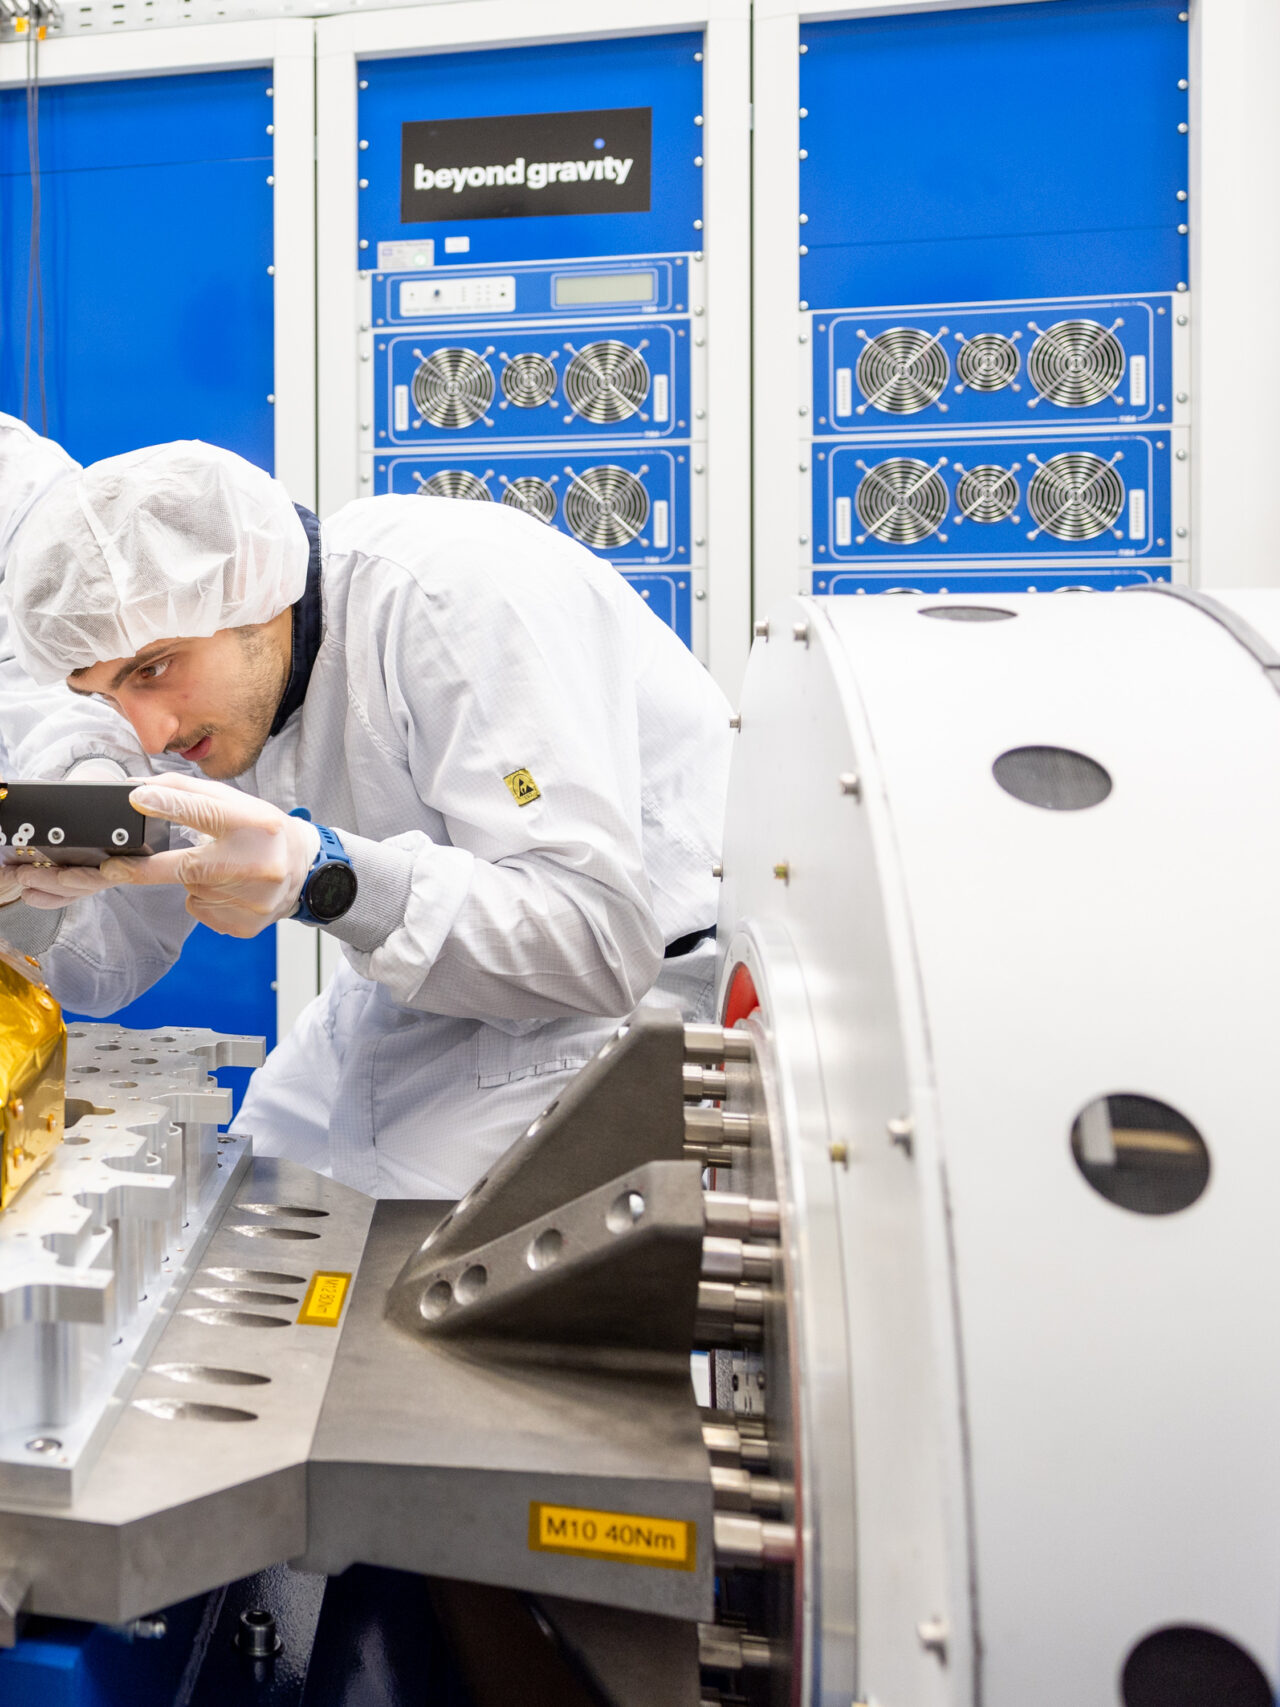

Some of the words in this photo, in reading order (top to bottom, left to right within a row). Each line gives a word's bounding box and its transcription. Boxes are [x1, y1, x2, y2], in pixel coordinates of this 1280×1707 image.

[413, 158, 525, 193] beyond
[527, 155, 634, 189] gravity
[545, 1516, 598, 1542] M10
[604, 1524, 677, 1550] 40Nm
